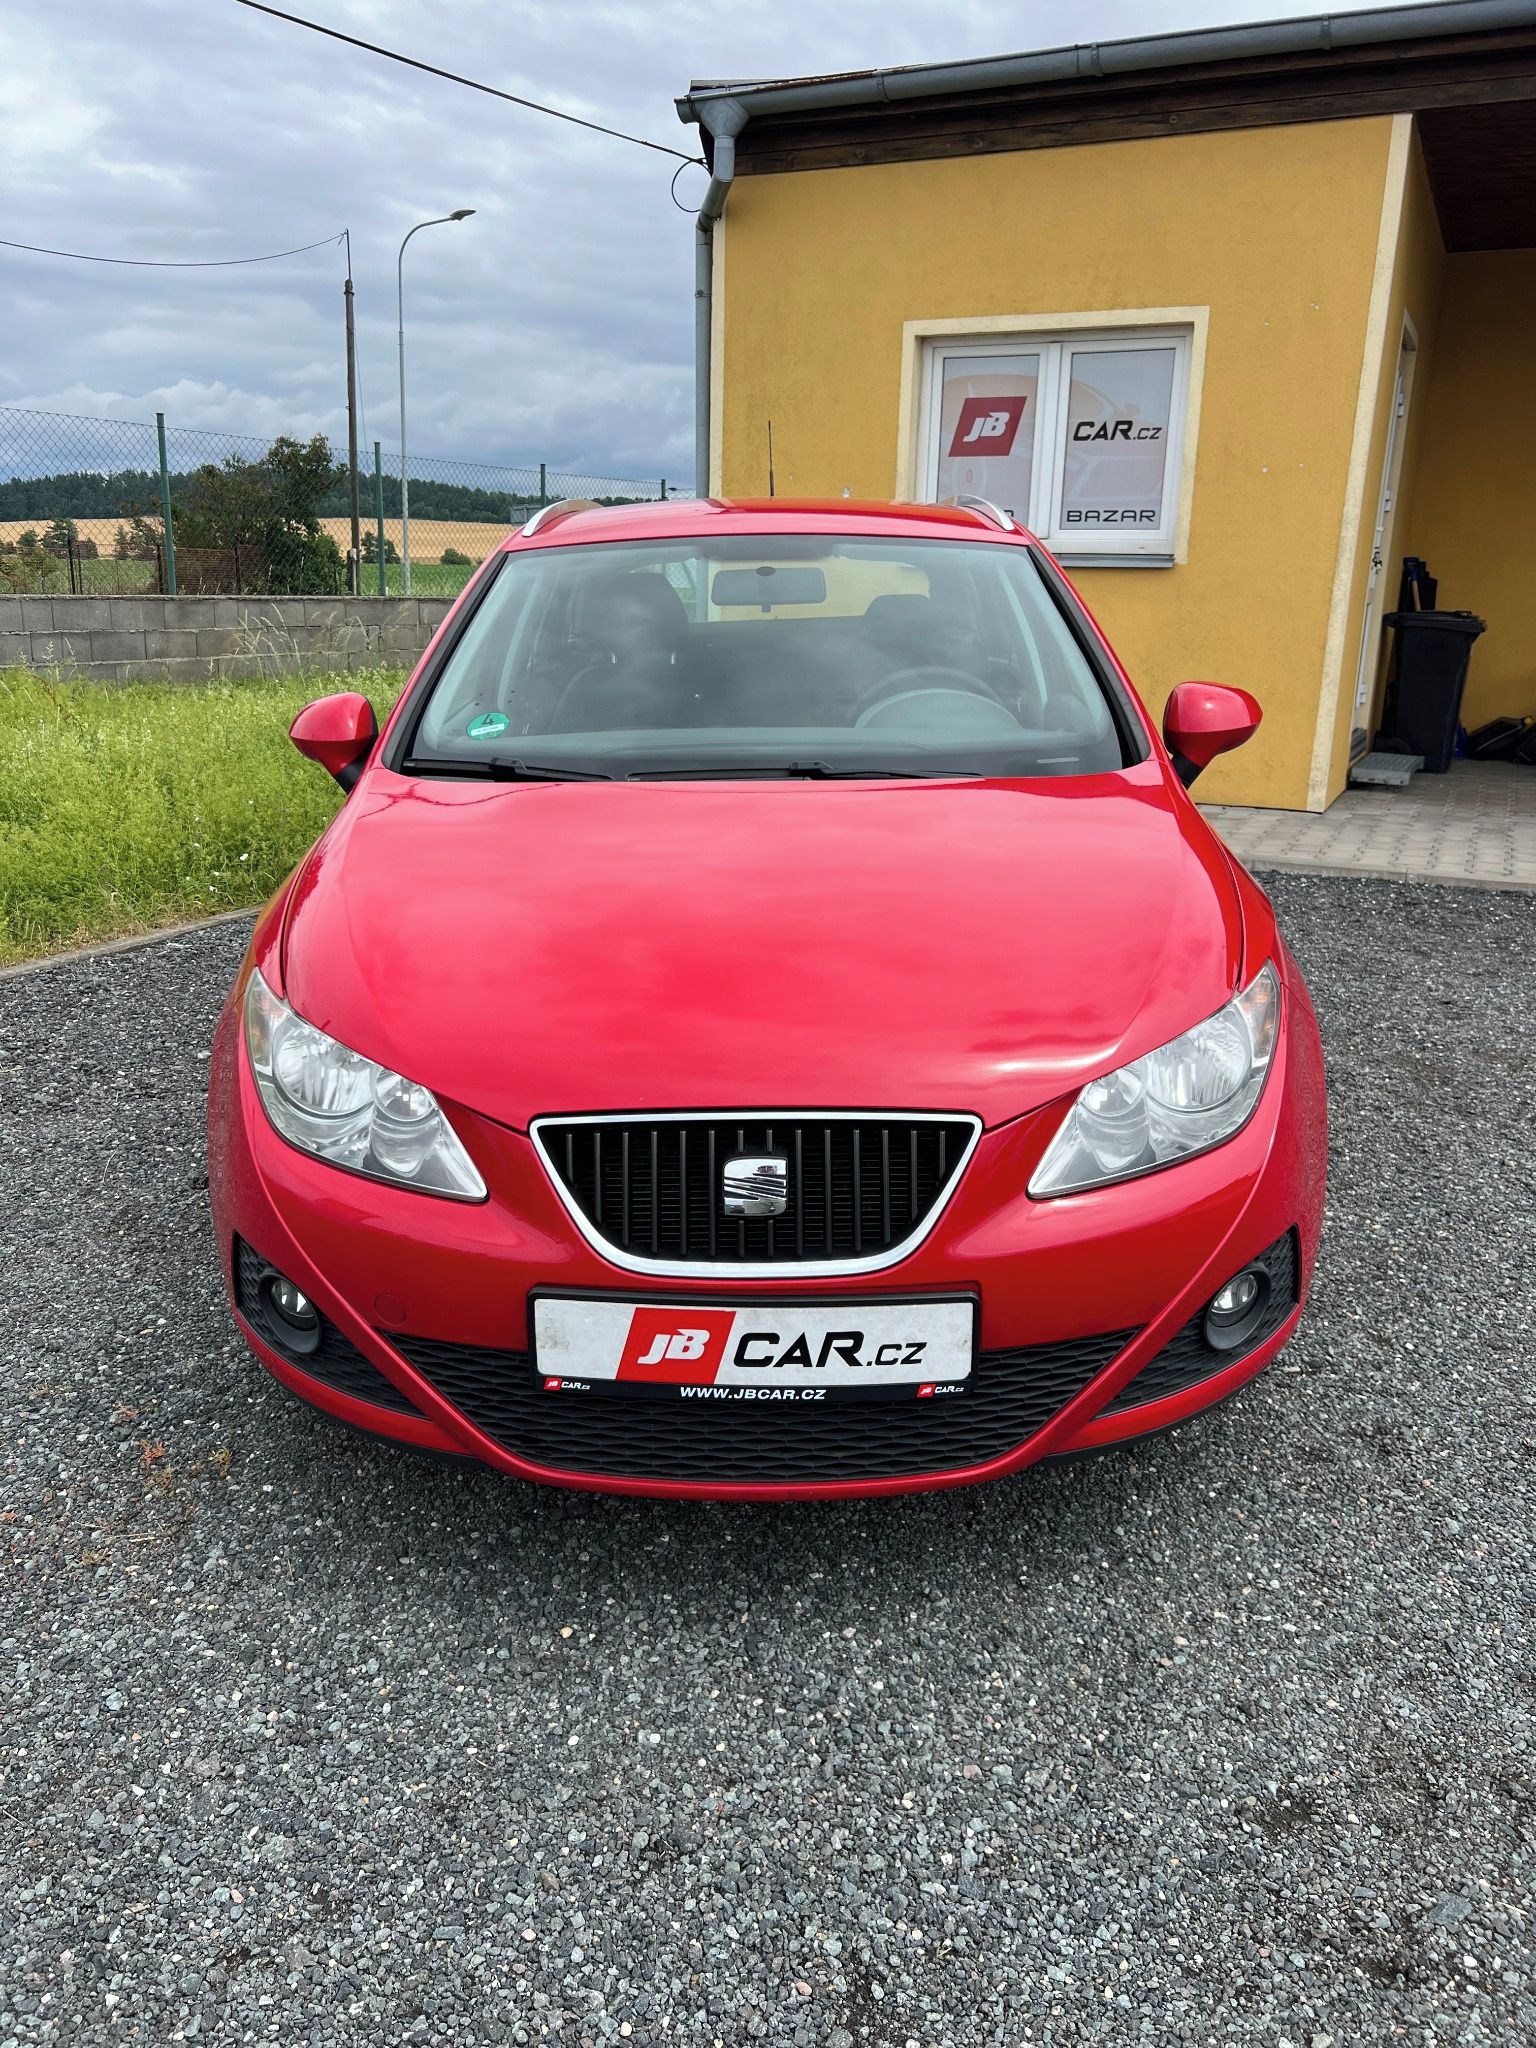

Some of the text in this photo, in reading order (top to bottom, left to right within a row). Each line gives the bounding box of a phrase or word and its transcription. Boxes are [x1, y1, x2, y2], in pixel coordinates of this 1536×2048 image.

[963, 412, 1009, 442] JB
[1067, 510, 1156, 522] BAZAR
[482, 714, 494, 725] 4
[637, 1329, 710, 1364] JB
[680, 1386, 827, 1400] WWW.JBCAR.CZ
